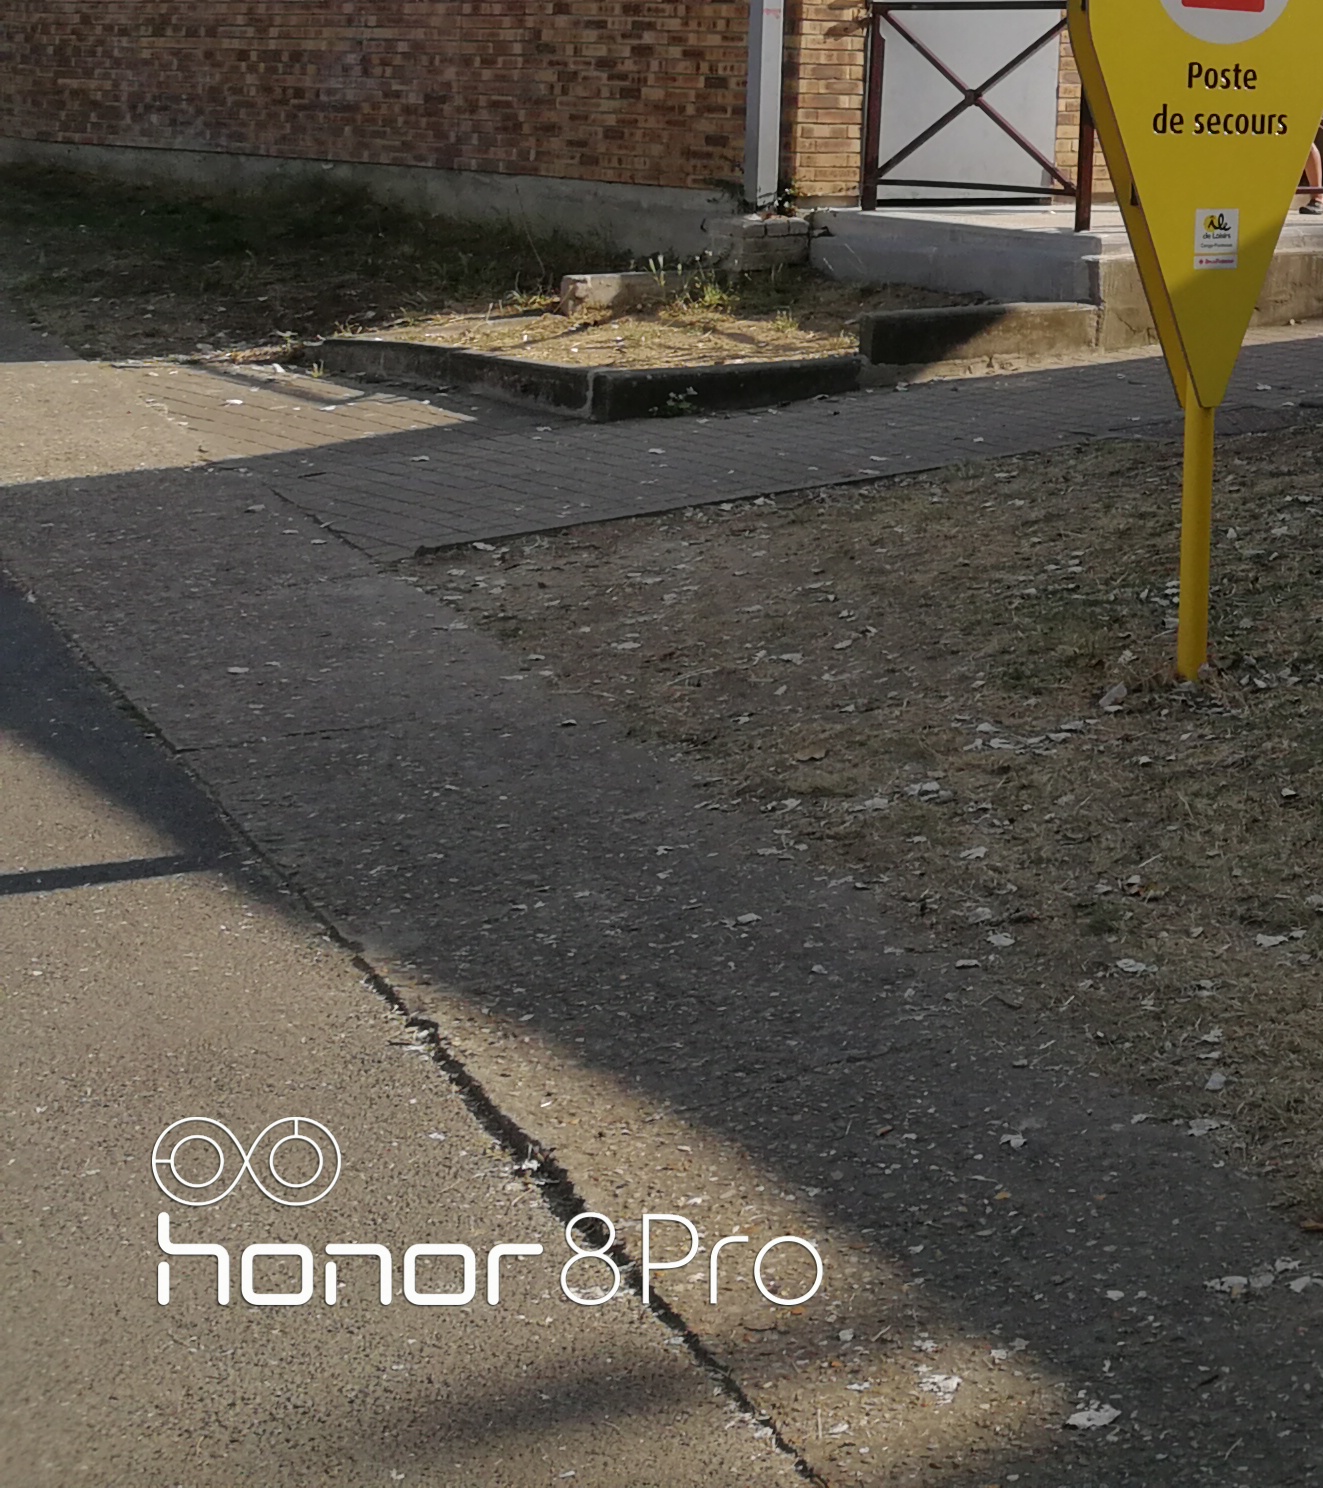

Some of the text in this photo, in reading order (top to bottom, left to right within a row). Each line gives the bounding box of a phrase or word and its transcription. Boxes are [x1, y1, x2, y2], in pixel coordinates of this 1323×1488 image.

[1187, 61, 1258, 90] Poste
[1152, 103, 1288, 135] de secours
